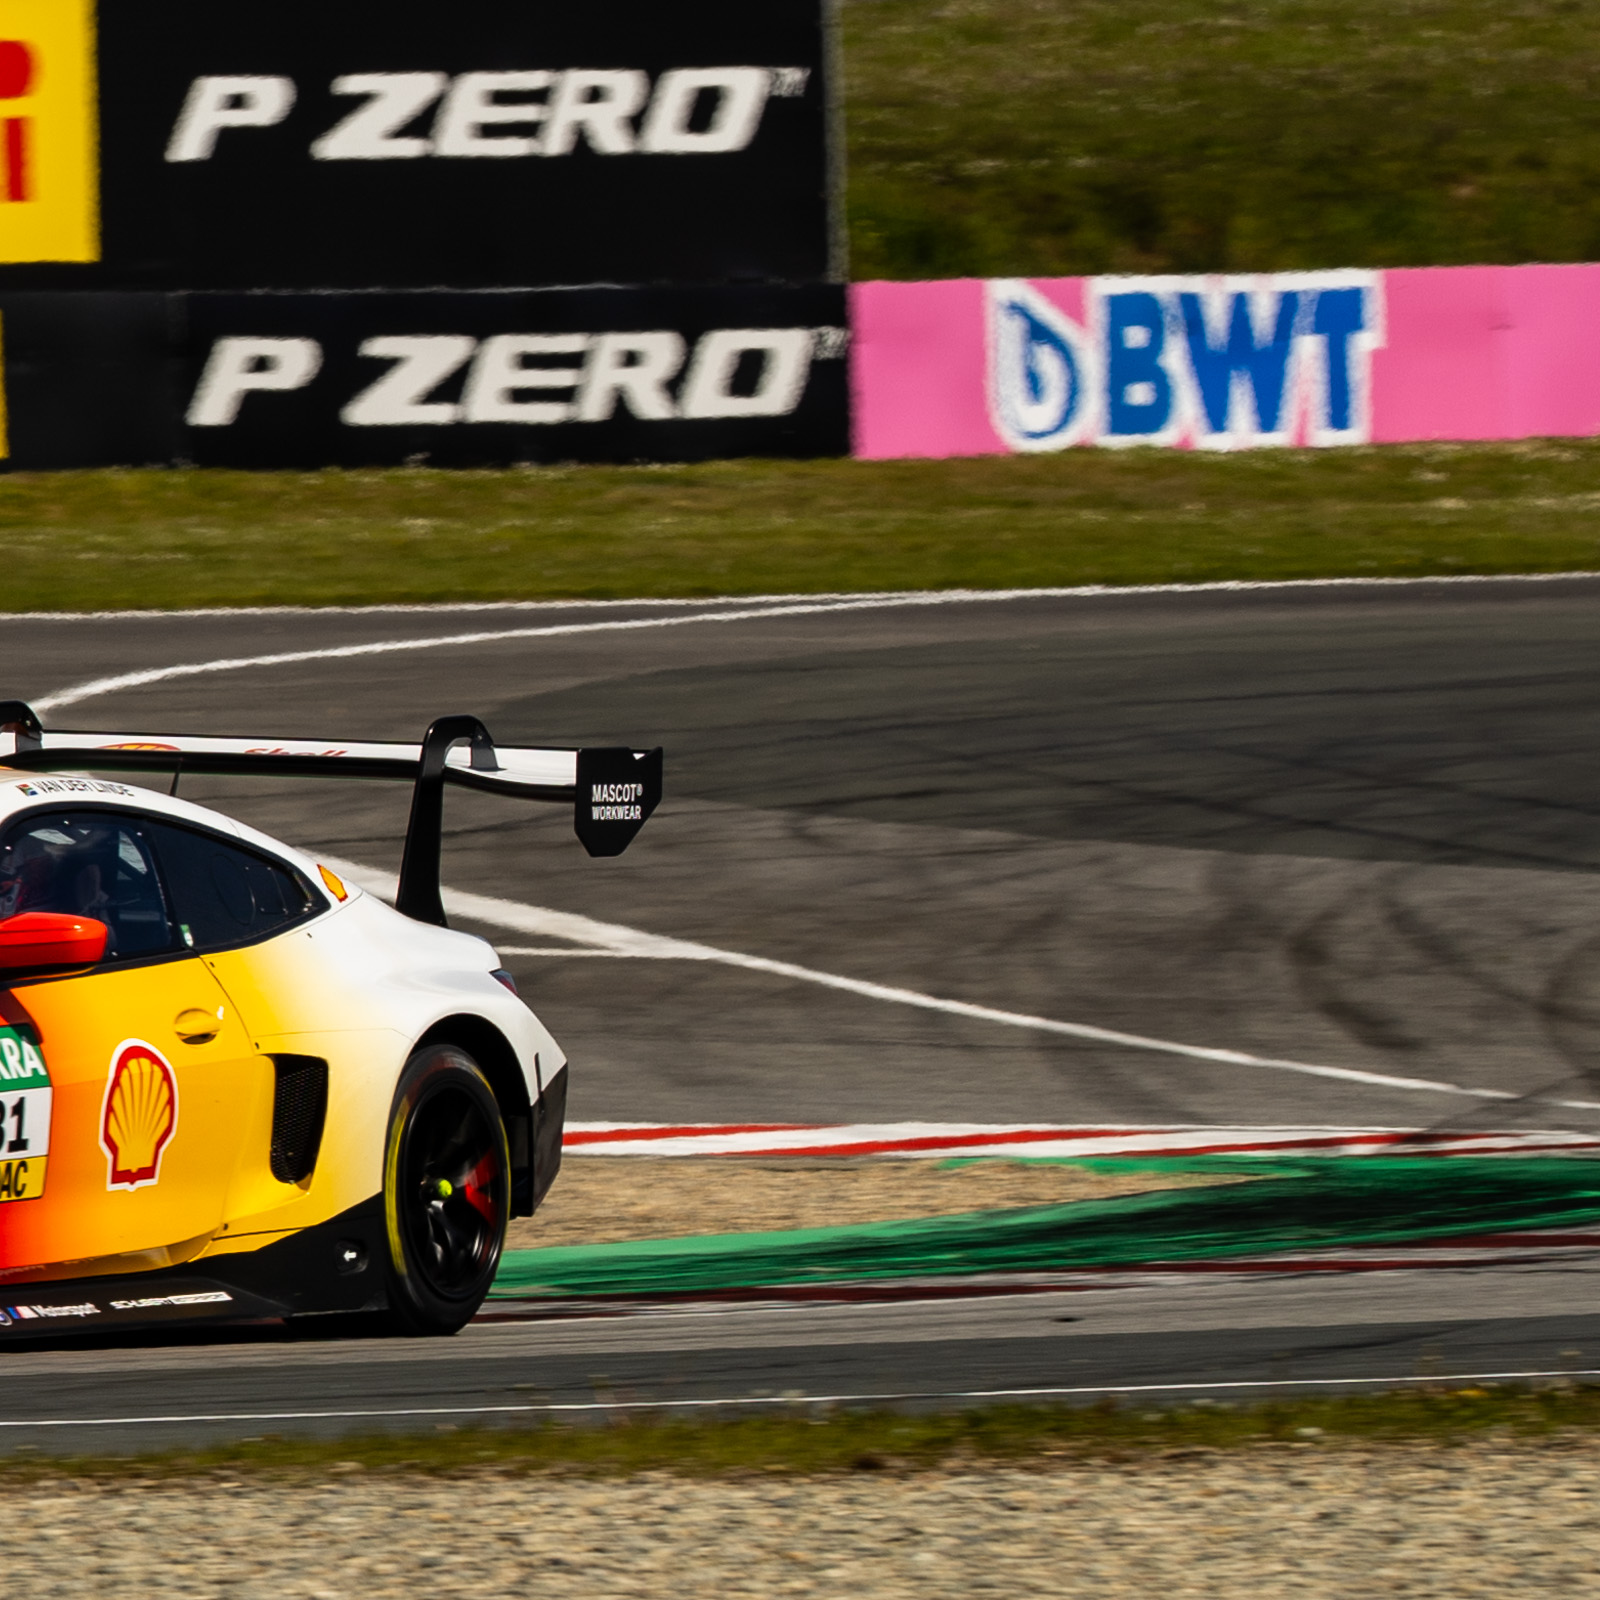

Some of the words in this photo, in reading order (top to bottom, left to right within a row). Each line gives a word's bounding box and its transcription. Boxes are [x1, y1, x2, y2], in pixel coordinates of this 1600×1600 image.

[163, 75, 298, 163] P
[186, 335, 324, 426] P
[1104, 284, 1368, 437] BWT
[36, 781, 65, 794] VAN
[65, 780, 91, 792] DER
[91, 782, 135, 797] LINDE
[592, 805, 642, 820] WORKWEAR
